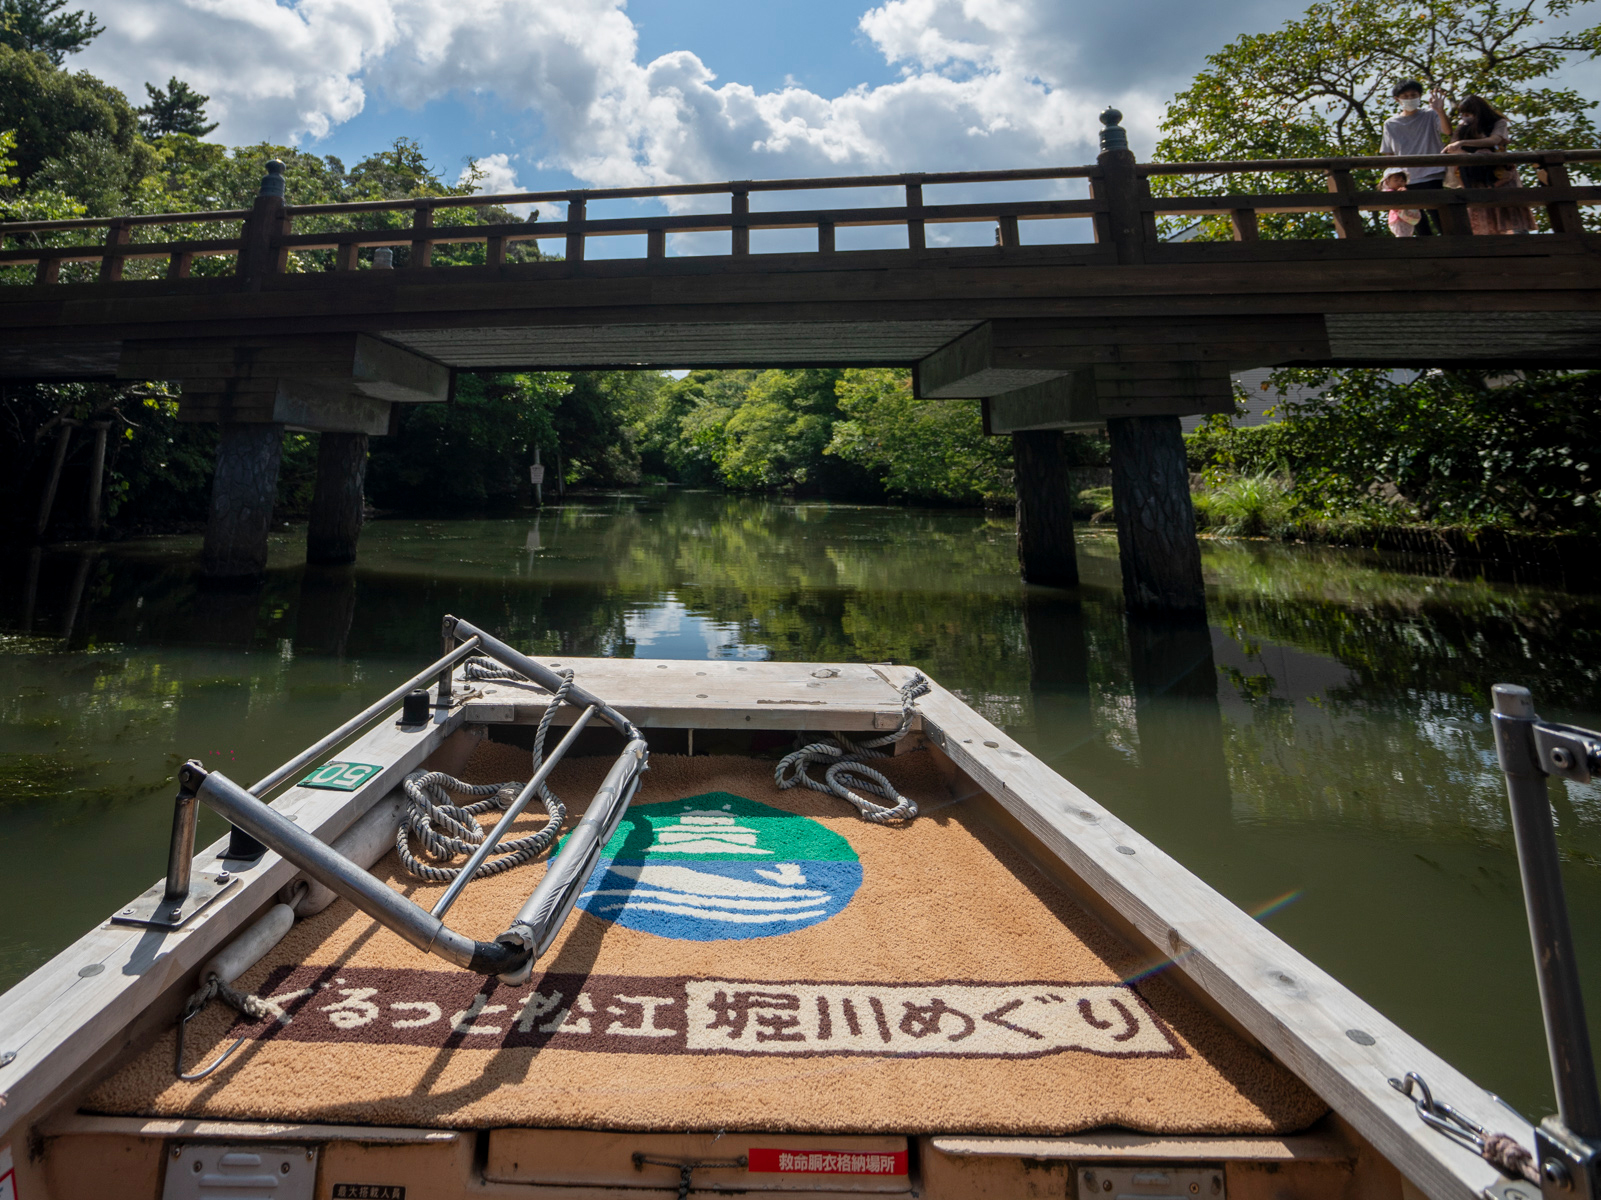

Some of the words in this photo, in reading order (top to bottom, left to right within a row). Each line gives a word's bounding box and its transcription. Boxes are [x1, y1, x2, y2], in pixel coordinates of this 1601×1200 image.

[311, 763, 373, 787] 50
[706, 991, 1140, 1042] 堀川めぐり
[779, 1152, 895, 1173] 救命胴衣格納場所
[337, 1186, 400, 1199] 最大搭載人員
